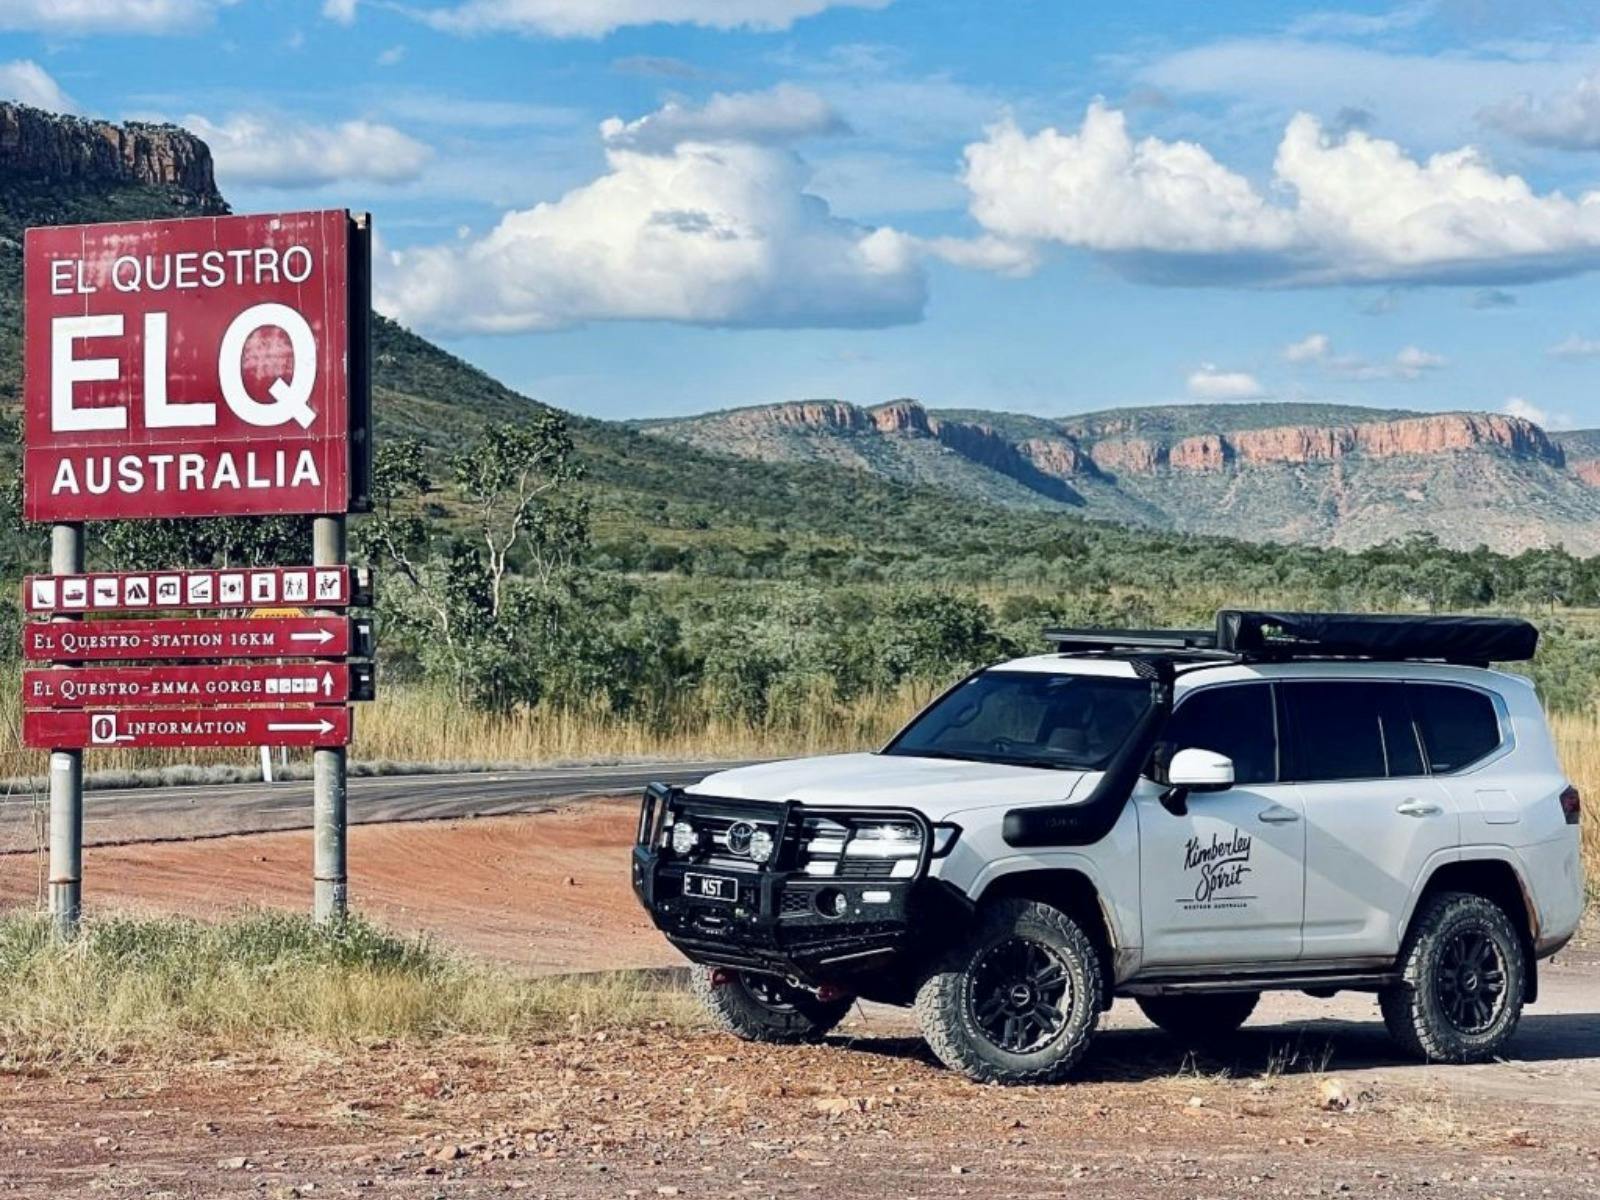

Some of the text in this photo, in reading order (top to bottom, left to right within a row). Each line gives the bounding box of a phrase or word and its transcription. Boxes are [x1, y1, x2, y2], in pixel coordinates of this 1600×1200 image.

[51, 246, 313, 295] EL QUESTRO
[51, 303, 317, 432] ELQ
[51, 450, 321, 495] AUSTRALIA
[231, 633, 275, 646] 16KM
[205, 680, 262, 694] GORGE
[127, 721, 246, 735] INFORMATION
[1184, 827, 1251, 872] Kimberley
[702, 878, 723, 897] KST
[1195, 863, 1252, 902] Spirit
